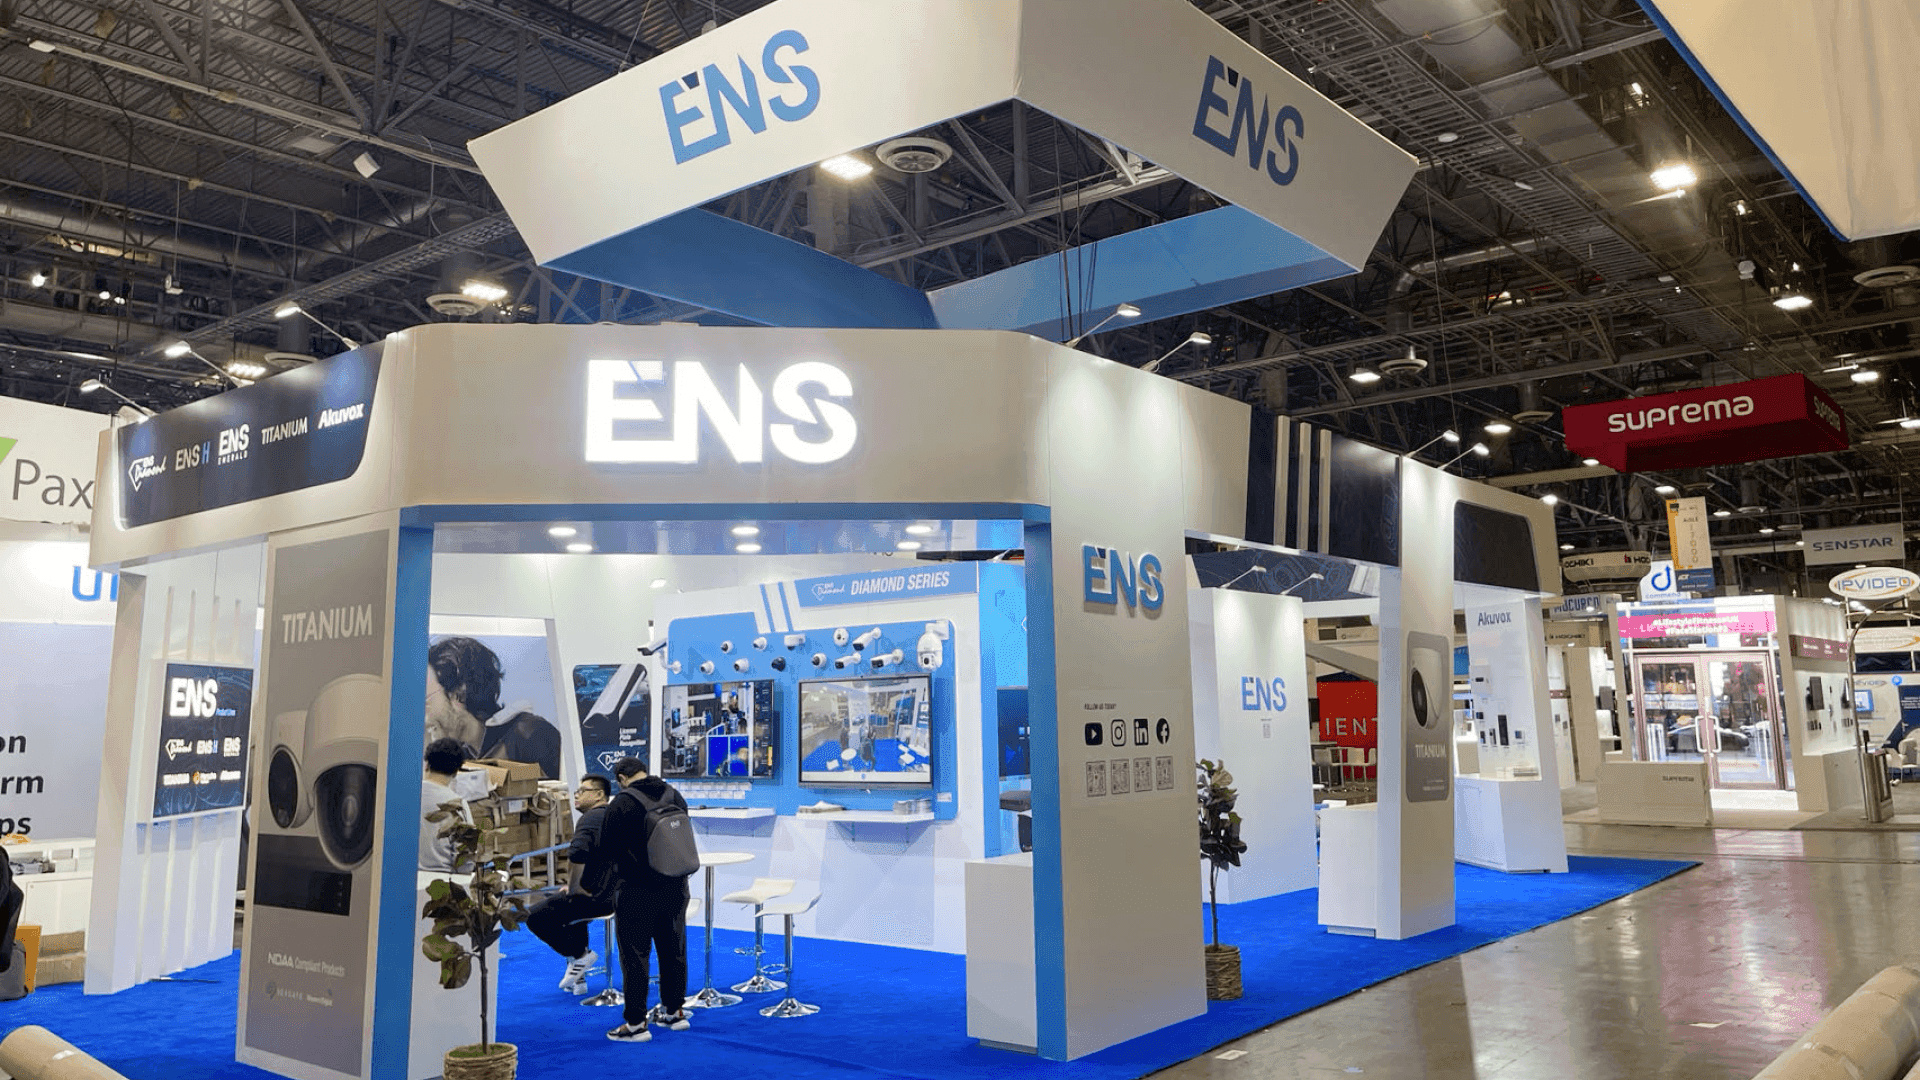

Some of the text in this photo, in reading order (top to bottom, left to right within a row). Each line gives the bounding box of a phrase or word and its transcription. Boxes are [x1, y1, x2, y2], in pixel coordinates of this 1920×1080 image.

[659, 29, 821, 164] ENS
[1192, 54, 1305, 186] ENS
[318, 403, 365, 430] Akuvox
[585, 360, 857, 463] ENS
[1608, 396, 1754, 433] suprema
[219, 423, 250, 456] ENS
[261, 416, 308, 445] TITANIUM
[175, 444, 200, 471] ENS
[1812, 537, 1893, 551] SENSTAR
[851, 571, 950, 595] DIAMOND SERIES
[1083, 544, 1164, 611] ENS
[1836, 577, 1911, 592] IPVIDEO
[282, 604, 373, 644] TITANIUM
[1478, 611, 1511, 626] Akuvox
[170, 678, 217, 717] ENS
[1241, 676, 1287, 711] ENS
